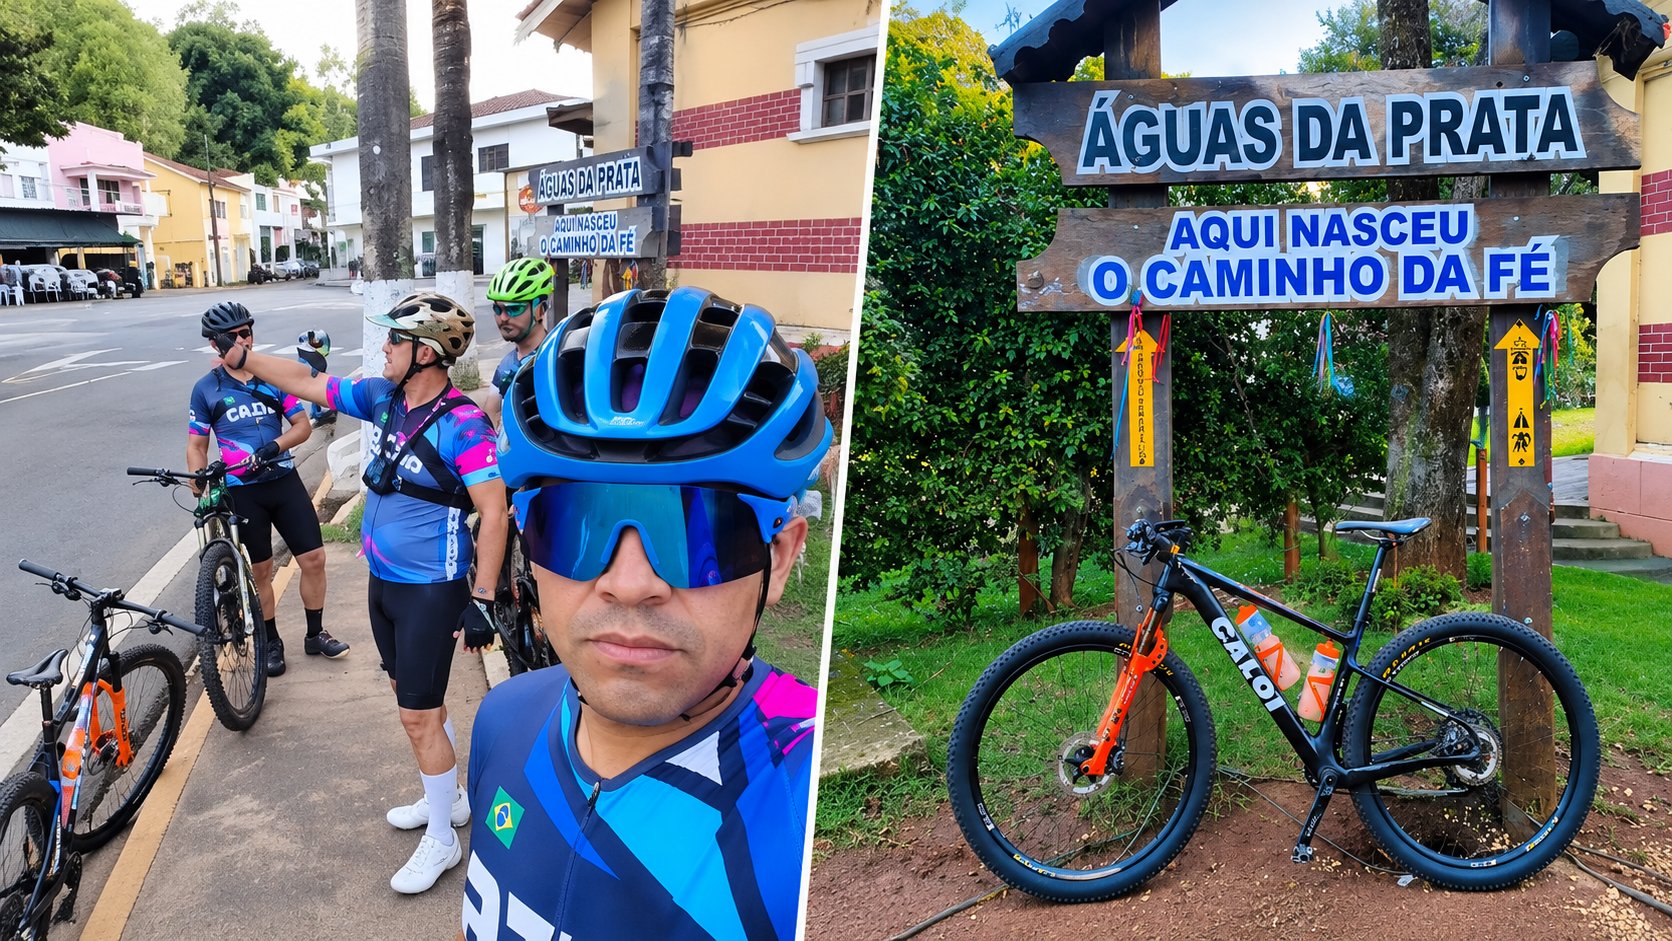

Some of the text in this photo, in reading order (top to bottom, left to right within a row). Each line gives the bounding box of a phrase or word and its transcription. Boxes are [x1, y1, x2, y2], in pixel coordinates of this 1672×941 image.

[1082, 93, 1579, 168] ÁGUAS DA PRATA
[538, 161, 640, 199] ÁGUAS DA PRATA
[540, 229, 634, 254] O CAMINHO DA FÉ
[555, 213, 617, 233] AQUI NASCEU
[1170, 210, 1469, 252] AQUI NASCEU
[1092, 242, 1550, 300] O CAMINHO DA FÉ
[1211, 616, 1286, 713] CALOI
